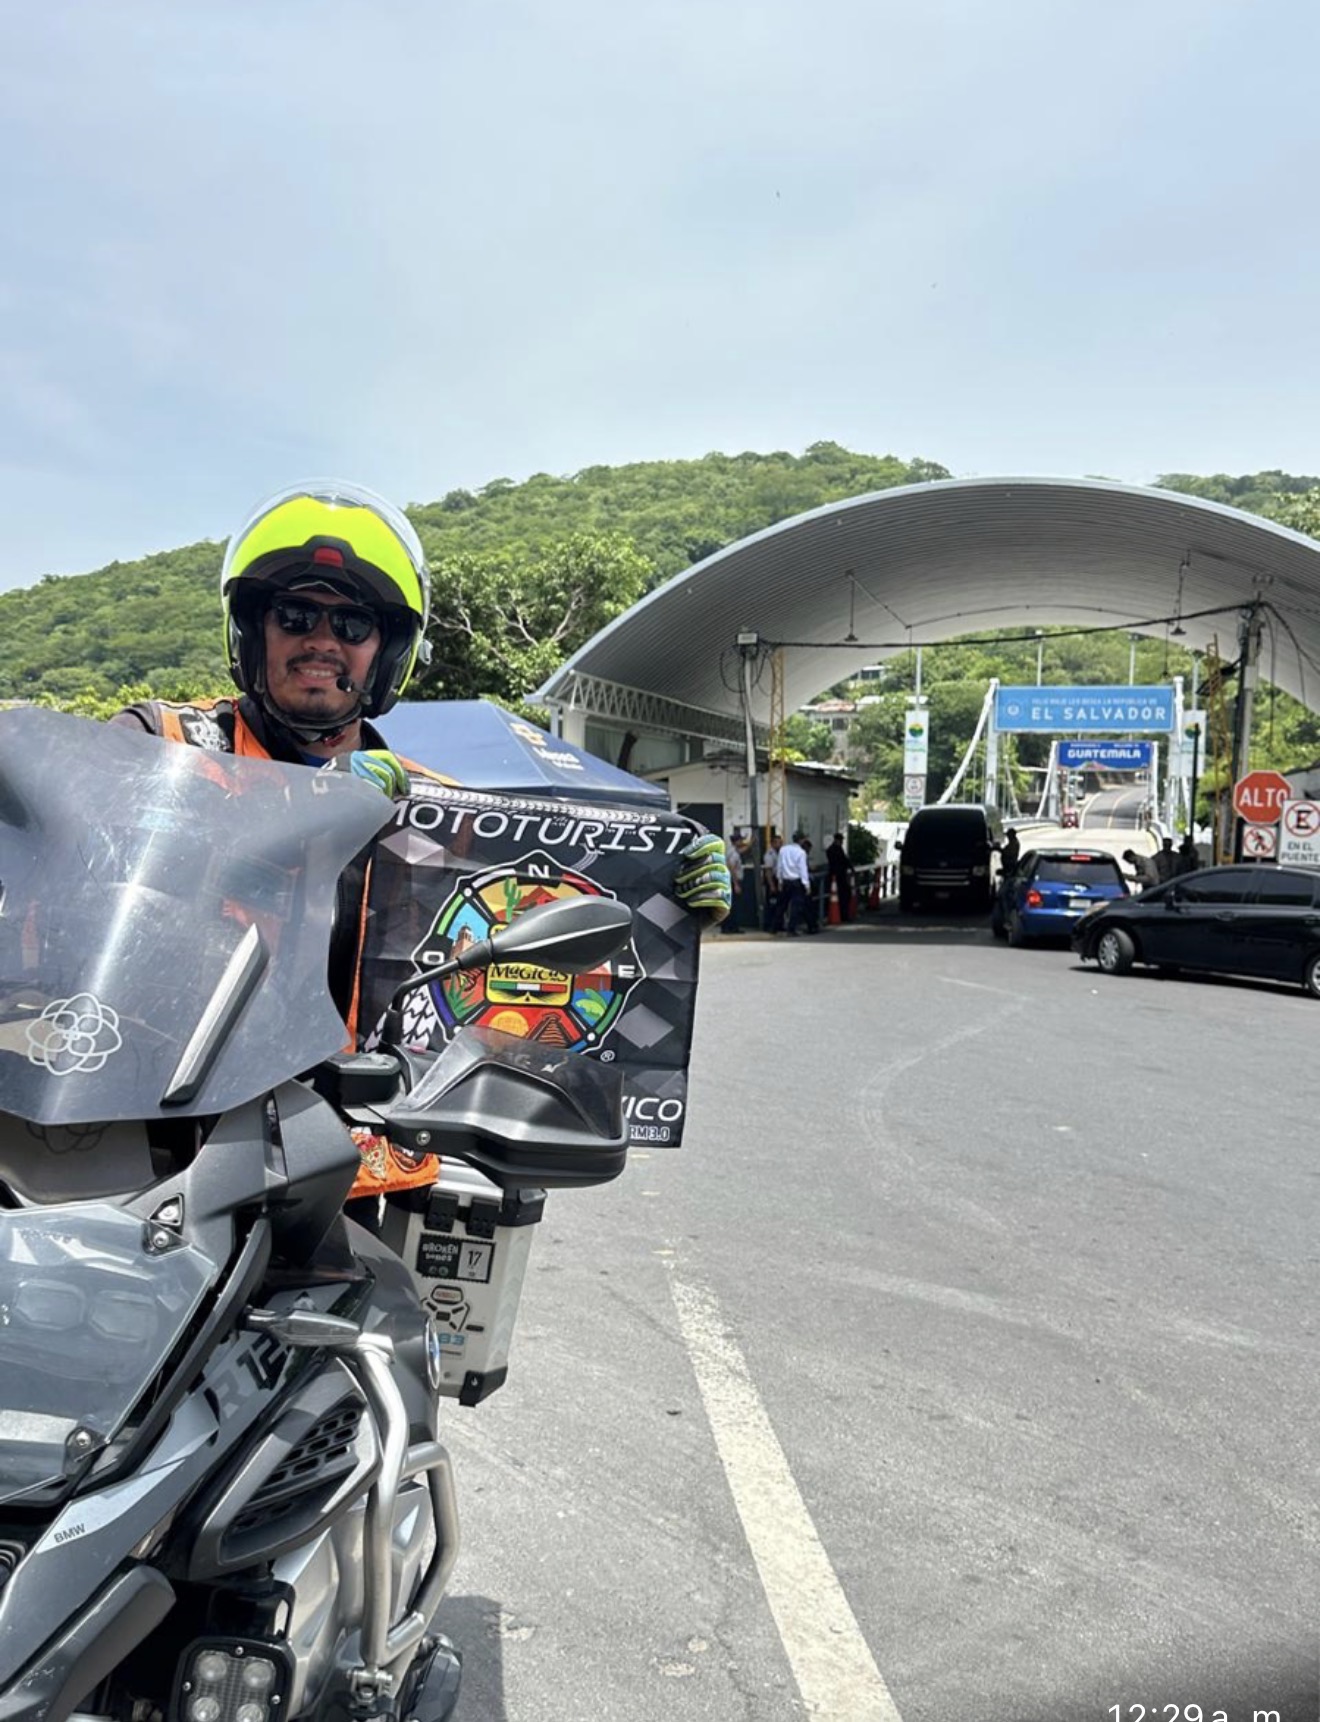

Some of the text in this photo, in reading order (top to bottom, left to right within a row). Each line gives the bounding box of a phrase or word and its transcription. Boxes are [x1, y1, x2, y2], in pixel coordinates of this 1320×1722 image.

[1031, 706, 1166, 720] EL SALVADOR
[1067, 748, 1142, 759] GUATEMALA
[1239, 786, 1288, 808] ALTO
[1287, 842, 1314, 851] EN EL
[1281, 851, 1320, 862] PUENTE
[528, 864, 550, 879] N
[422, 951, 444, 965] O
[617, 964, 636, 978] E
[621, 1095, 684, 1122] ICO
[468, 1250, 483, 1266] 17
[53, 1523, 86, 1543] BMW
